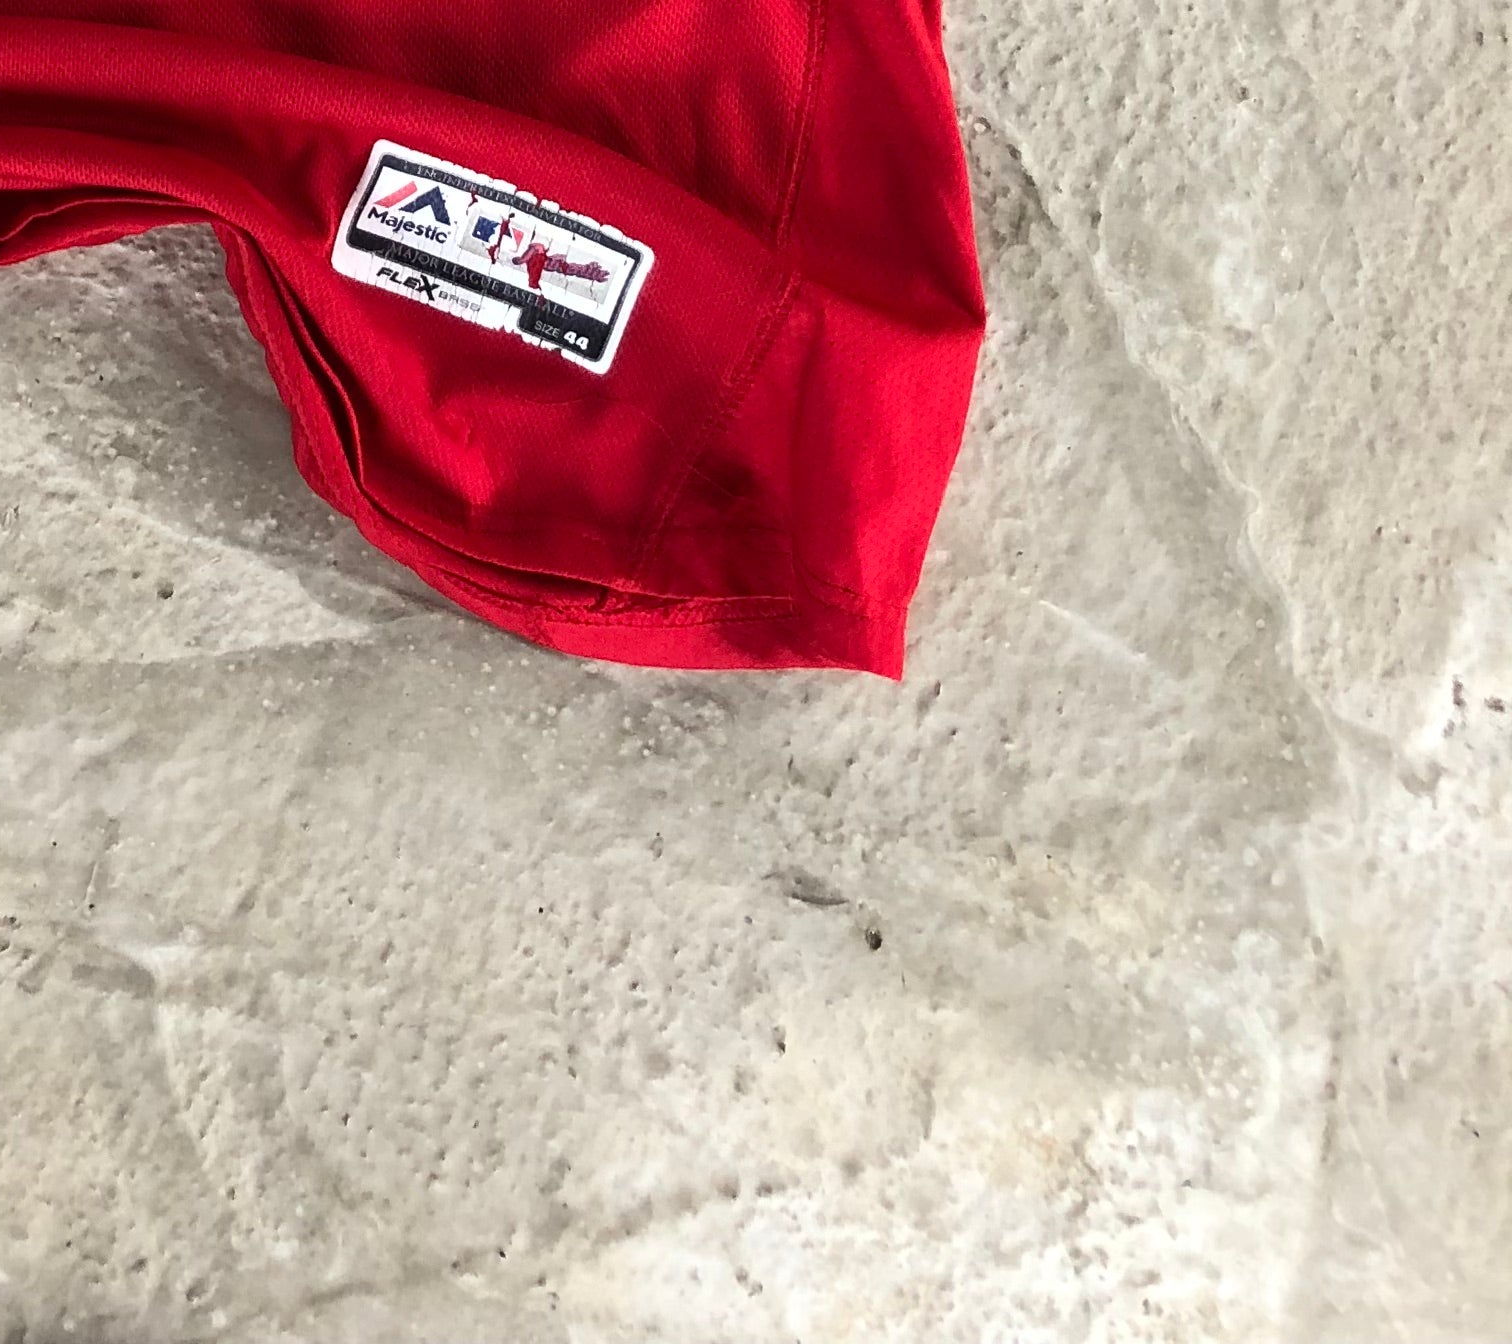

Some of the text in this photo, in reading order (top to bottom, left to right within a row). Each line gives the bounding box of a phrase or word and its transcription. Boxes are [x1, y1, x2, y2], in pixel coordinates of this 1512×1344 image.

[367, 206, 448, 244] Majestic
[578, 226, 603, 242] FOR
[376, 266, 440, 302] FLEX
[389, 242, 438, 269] MAJOR
[442, 261, 500, 292] LEAGUE
[534, 320, 590, 351] SIZE 44
